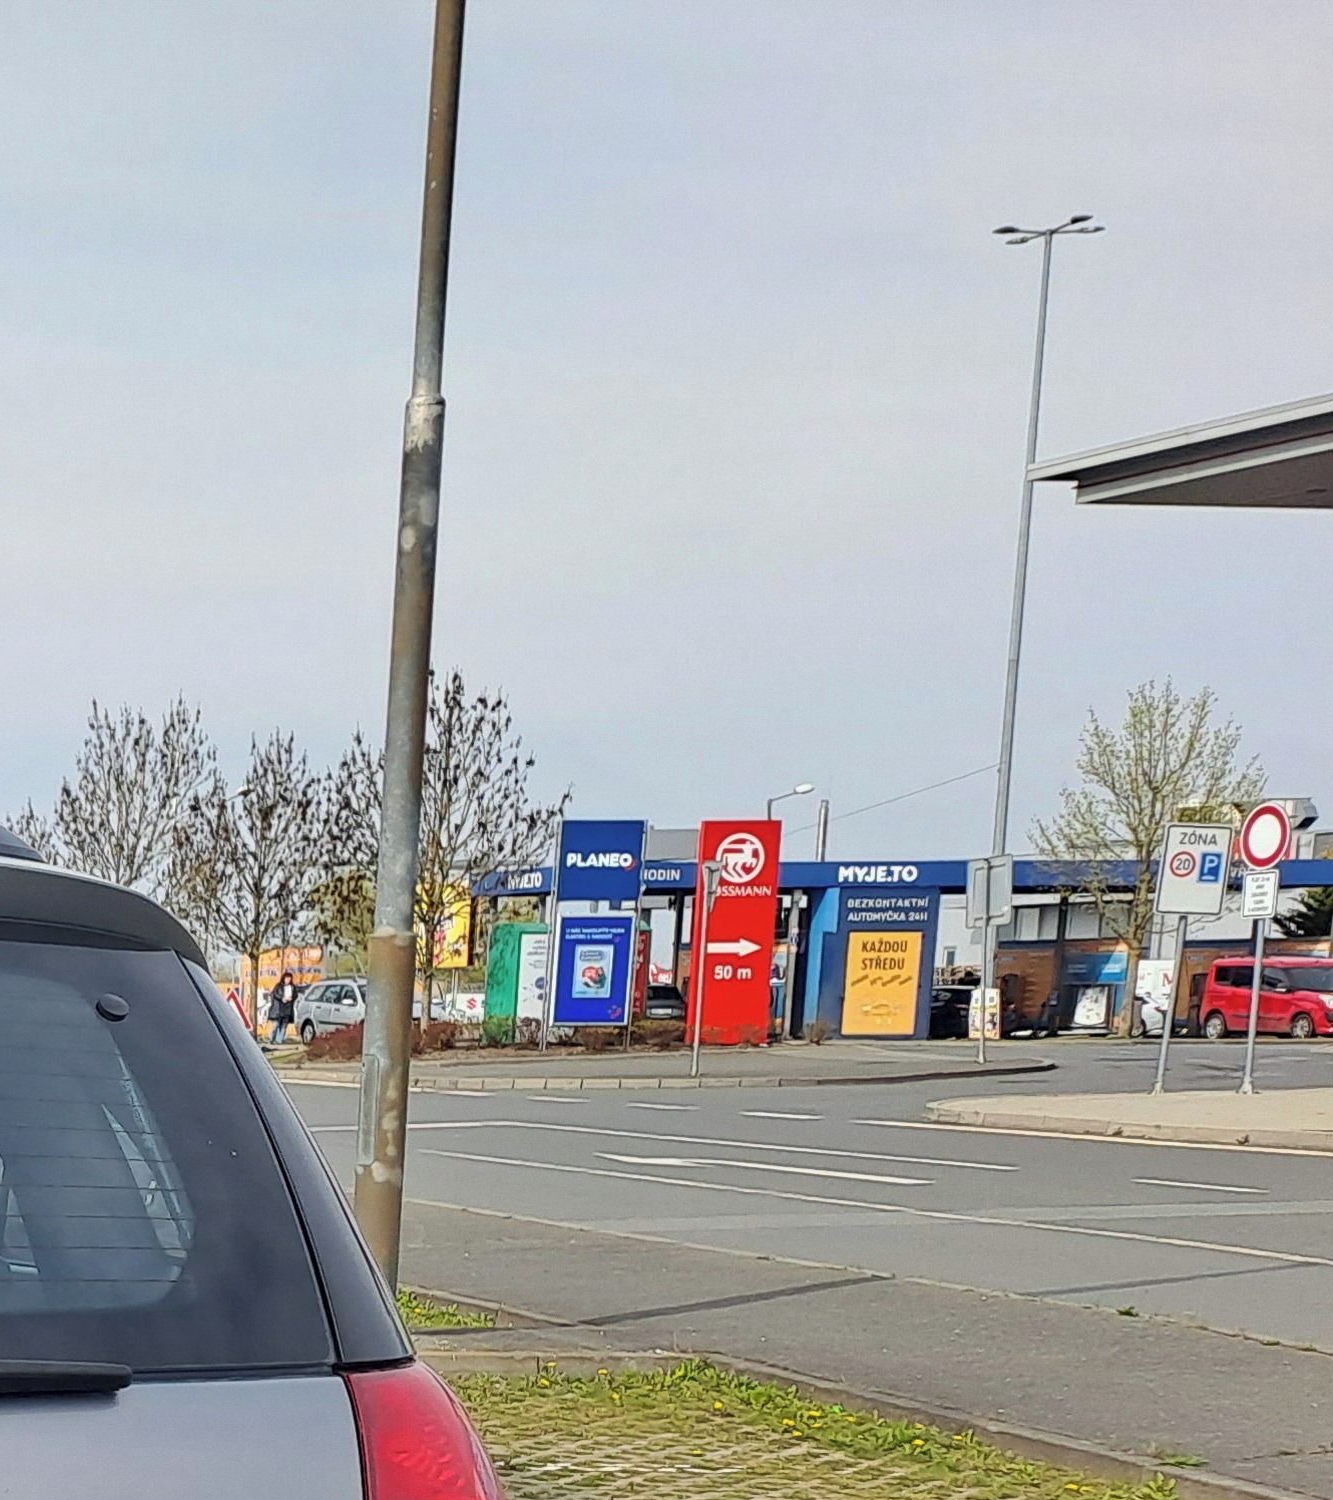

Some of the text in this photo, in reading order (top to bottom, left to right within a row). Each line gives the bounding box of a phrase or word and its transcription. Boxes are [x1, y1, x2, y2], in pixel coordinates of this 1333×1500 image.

[1179, 830, 1218, 846] ZÓNA
[566, 852, 633, 869] PLANEO
[1175, 858, 1190, 871] 20
[1204, 856, 1218, 873] P
[838, 865, 918, 883] MYJE.TO
[847, 896, 930, 909] BEZKONTAKTNÍ
[847, 910, 906, 922] AUTOMYČKA
[861, 937, 908, 953] KAŽDOU
[861, 955, 905, 971] STŘEDU
[714, 965, 752, 980] 50 m
